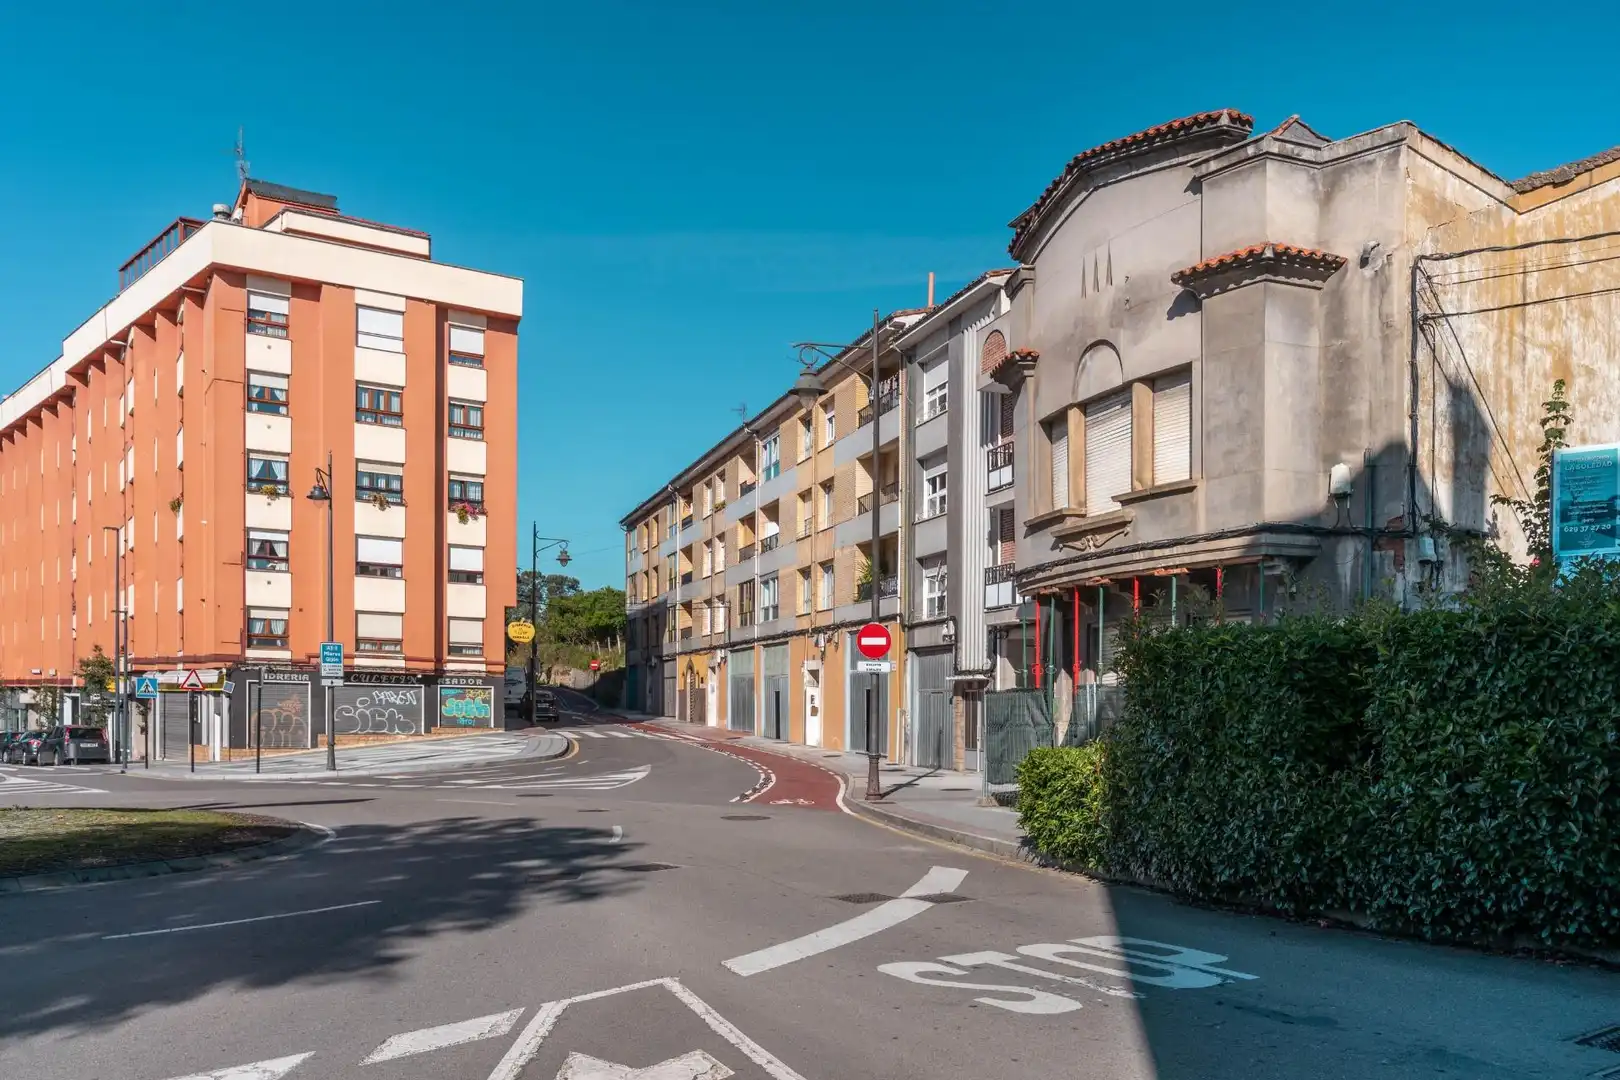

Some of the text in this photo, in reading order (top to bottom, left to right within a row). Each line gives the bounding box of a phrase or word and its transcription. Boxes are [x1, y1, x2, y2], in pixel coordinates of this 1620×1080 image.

[1575, 460, 1613, 470] SOLEDAD
[263, 673, 309, 681] IDRERIA
[350, 673, 417, 684] CULETIN
[876, 935, 1261, 1014] STOP
